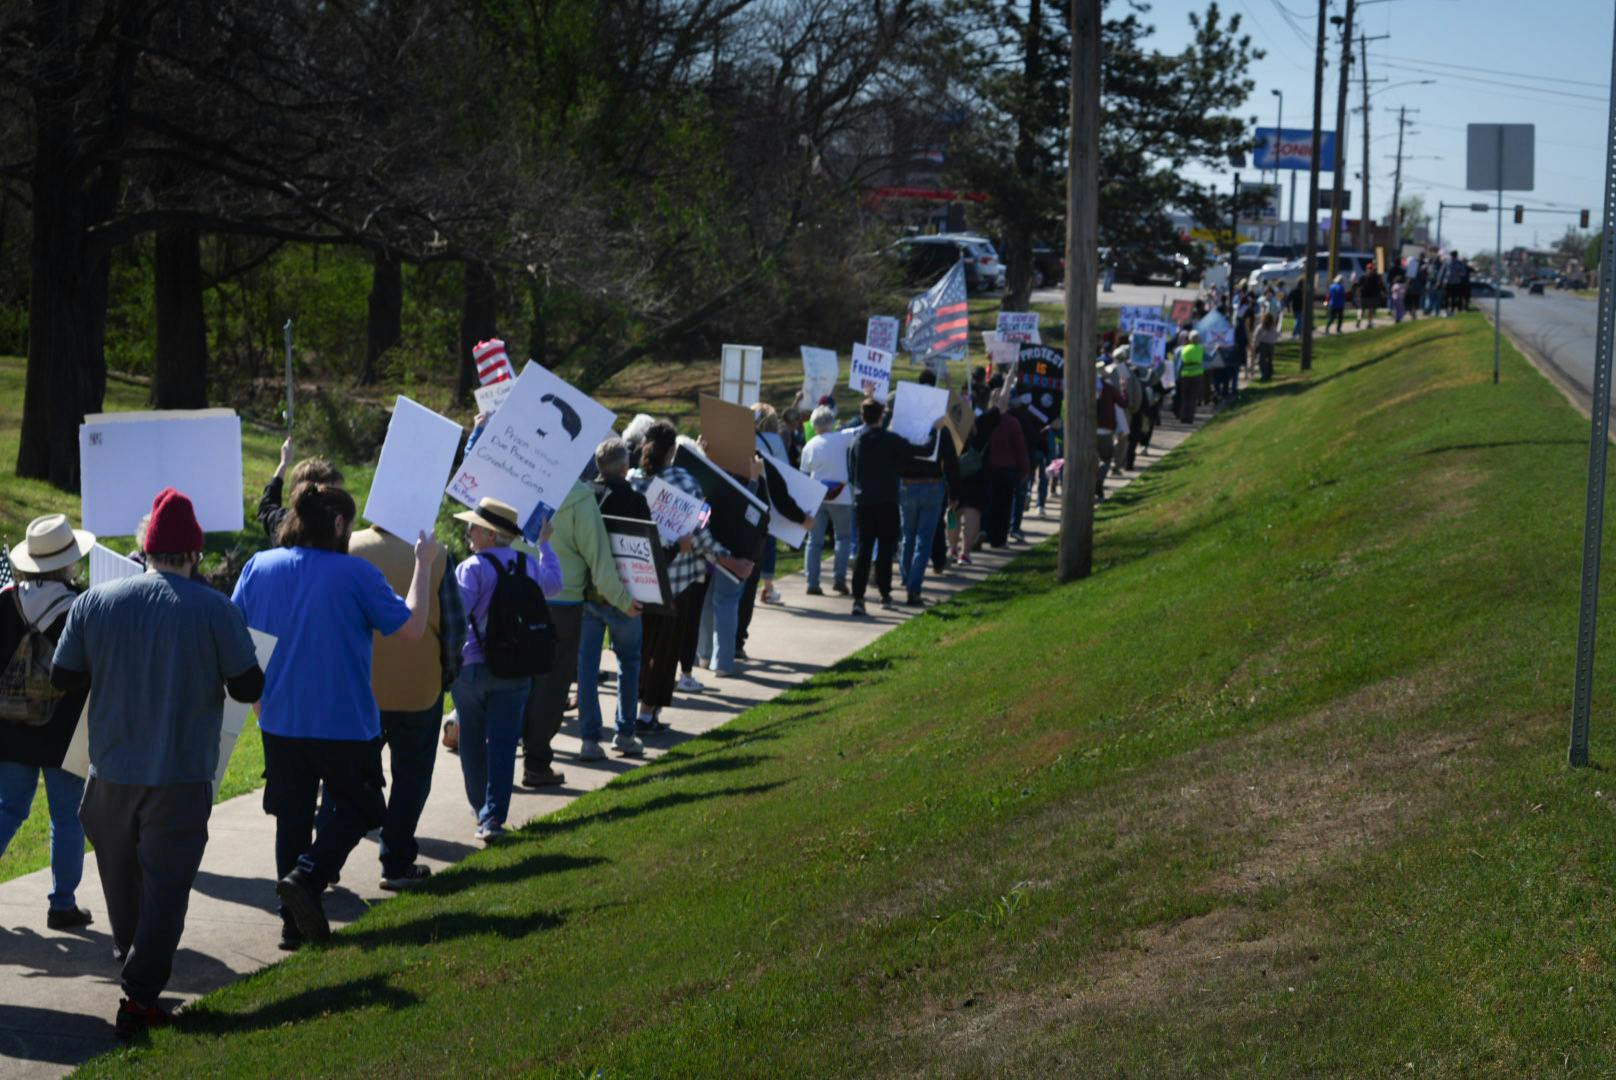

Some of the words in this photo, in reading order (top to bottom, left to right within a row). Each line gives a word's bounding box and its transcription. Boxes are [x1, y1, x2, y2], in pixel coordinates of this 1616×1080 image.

[867, 350, 883, 363] LET
[853, 359, 890, 381] FREEDOM
[657, 488, 673, 505] NO
